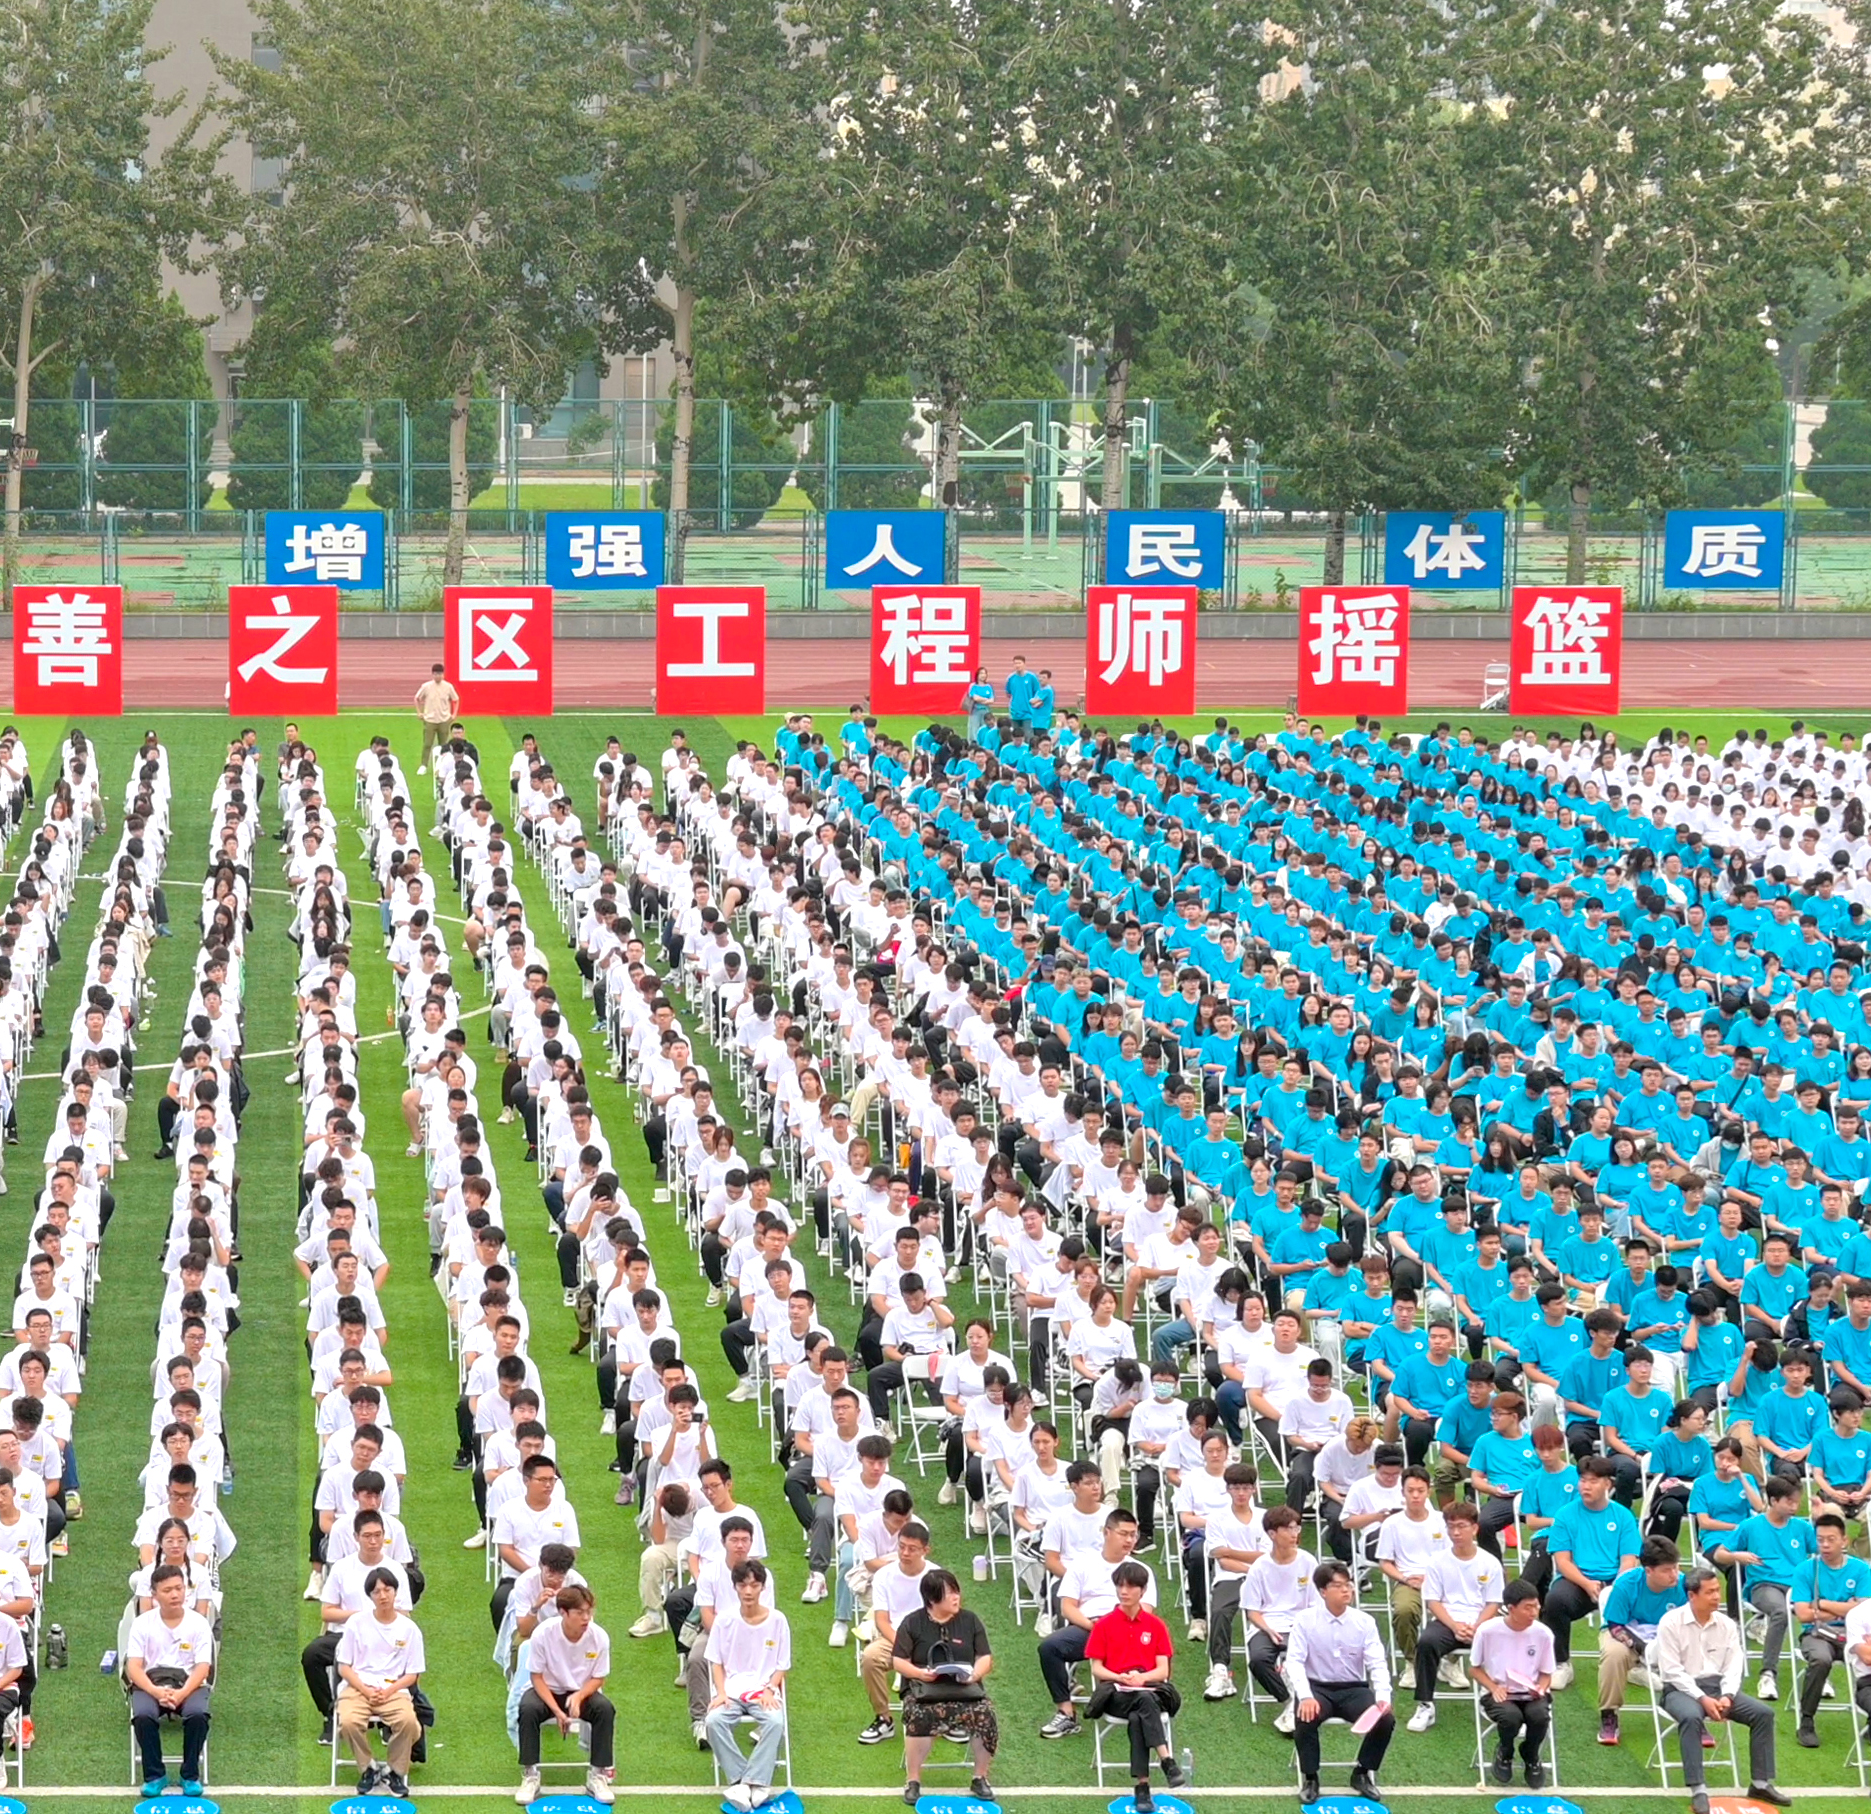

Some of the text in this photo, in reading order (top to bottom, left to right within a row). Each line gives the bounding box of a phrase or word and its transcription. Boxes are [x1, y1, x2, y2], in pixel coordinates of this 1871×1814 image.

[285, 524, 367, 580] 增
[569, 526, 647, 577] 强
[844, 525, 922, 576] 人
[1126, 525, 1202, 577] 民
[1404, 524, 1485, 578] 体
[1683, 525, 1765, 577] 质
[23, 594, 111, 686] 善
[238, 596, 327, 683] 之
[459, 599, 538, 684] 区
[668, 603, 755, 676] 工
[881, 595, 970, 685] 程
[1099, 594, 1185, 685] 师
[1309, 594, 1400, 686] 摇
[1522, 597, 1611, 684] 篮
